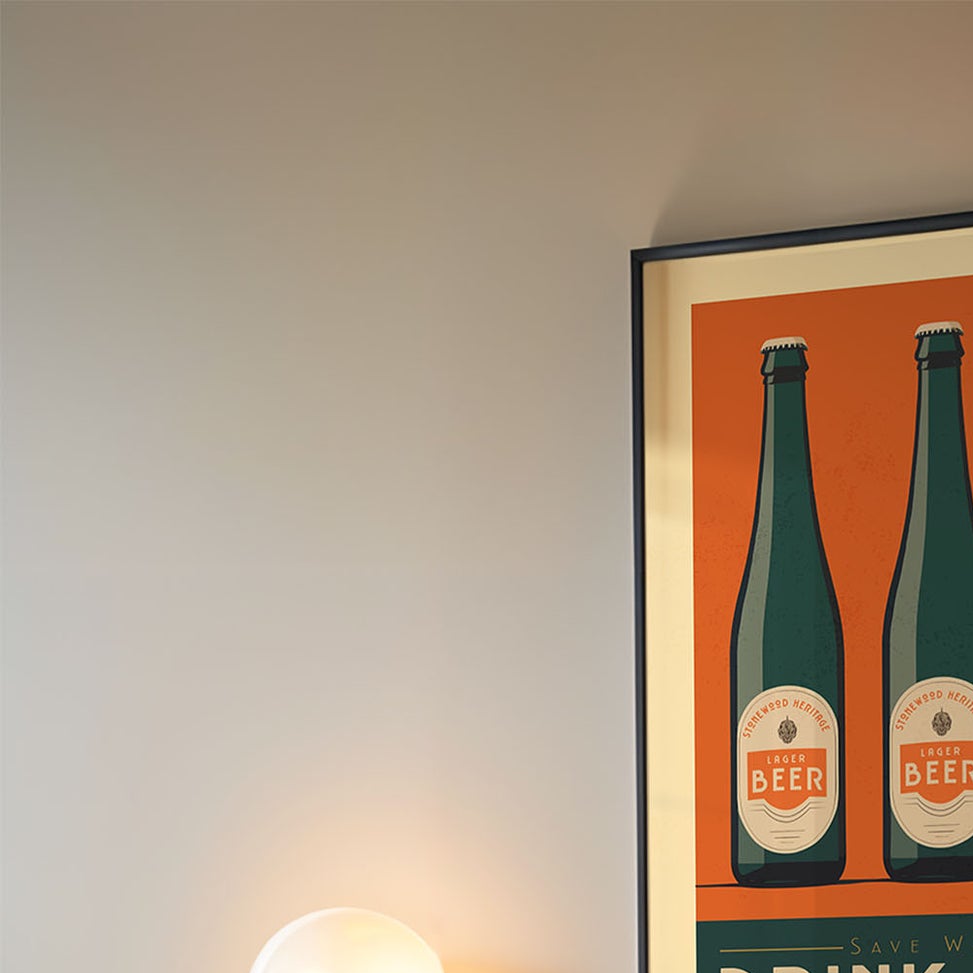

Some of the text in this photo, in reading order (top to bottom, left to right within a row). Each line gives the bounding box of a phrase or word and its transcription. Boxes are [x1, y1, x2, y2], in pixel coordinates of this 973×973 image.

[742, 698, 831, 739] STONEWOOD HERITAGE
[895, 690, 943, 731] STONEWOOD
[767, 753, 806, 765] LAGER
[920, 746, 961, 758] LAGER
[752, 766, 823, 794] BEER
